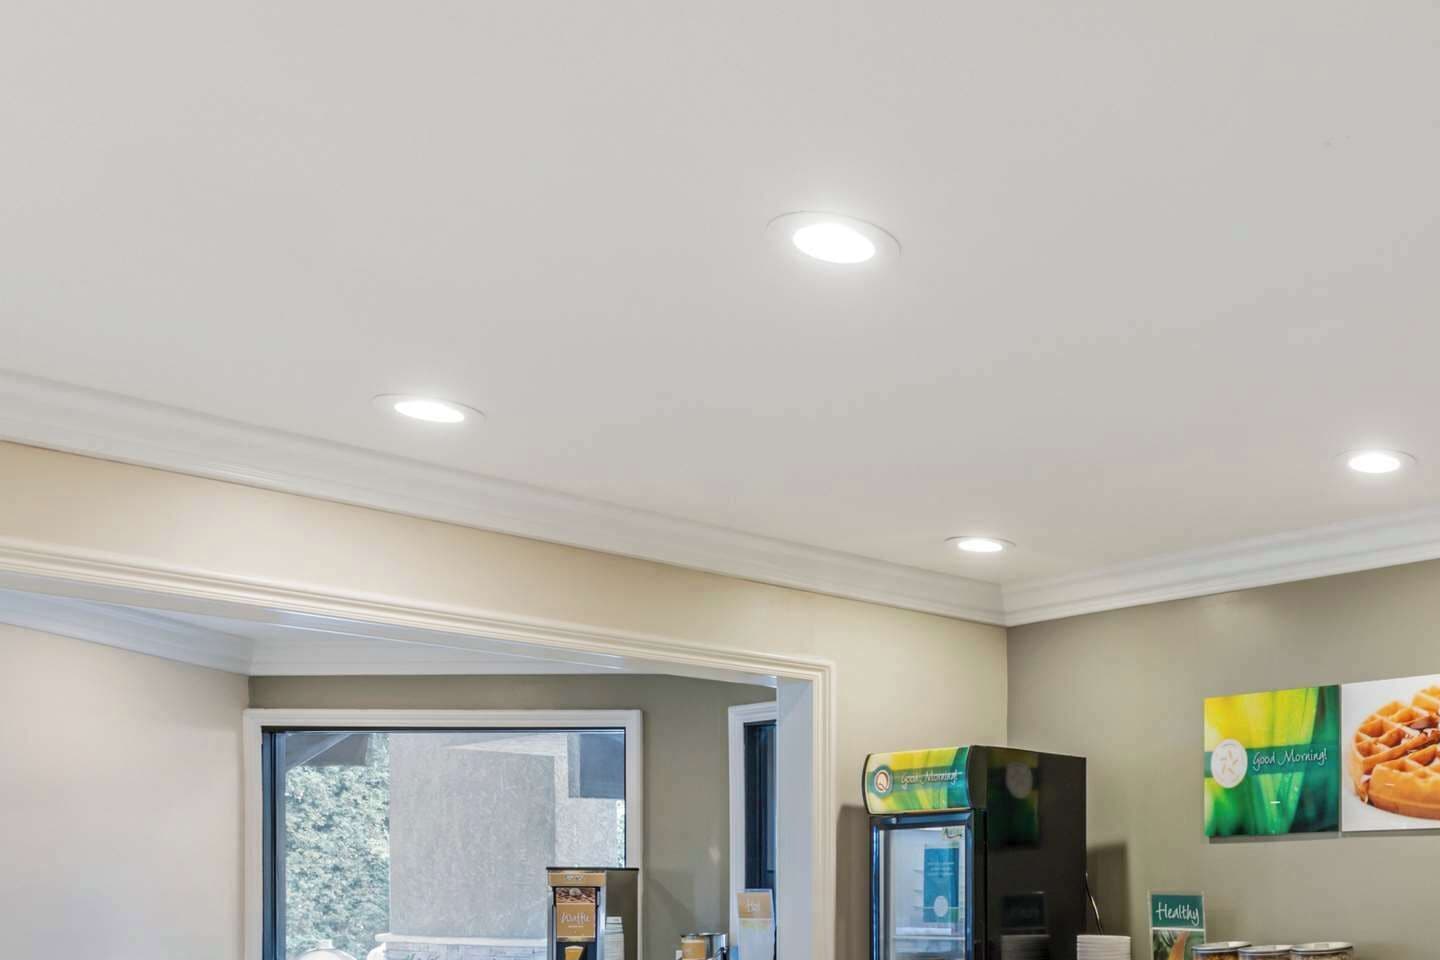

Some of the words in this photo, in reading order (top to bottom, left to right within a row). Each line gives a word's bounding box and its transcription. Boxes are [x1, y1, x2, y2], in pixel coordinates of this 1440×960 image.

[1252, 751, 1275, 772] Good
[1277, 747, 1328, 766] Morning!
[1155, 901, 1200, 927] Healthy
